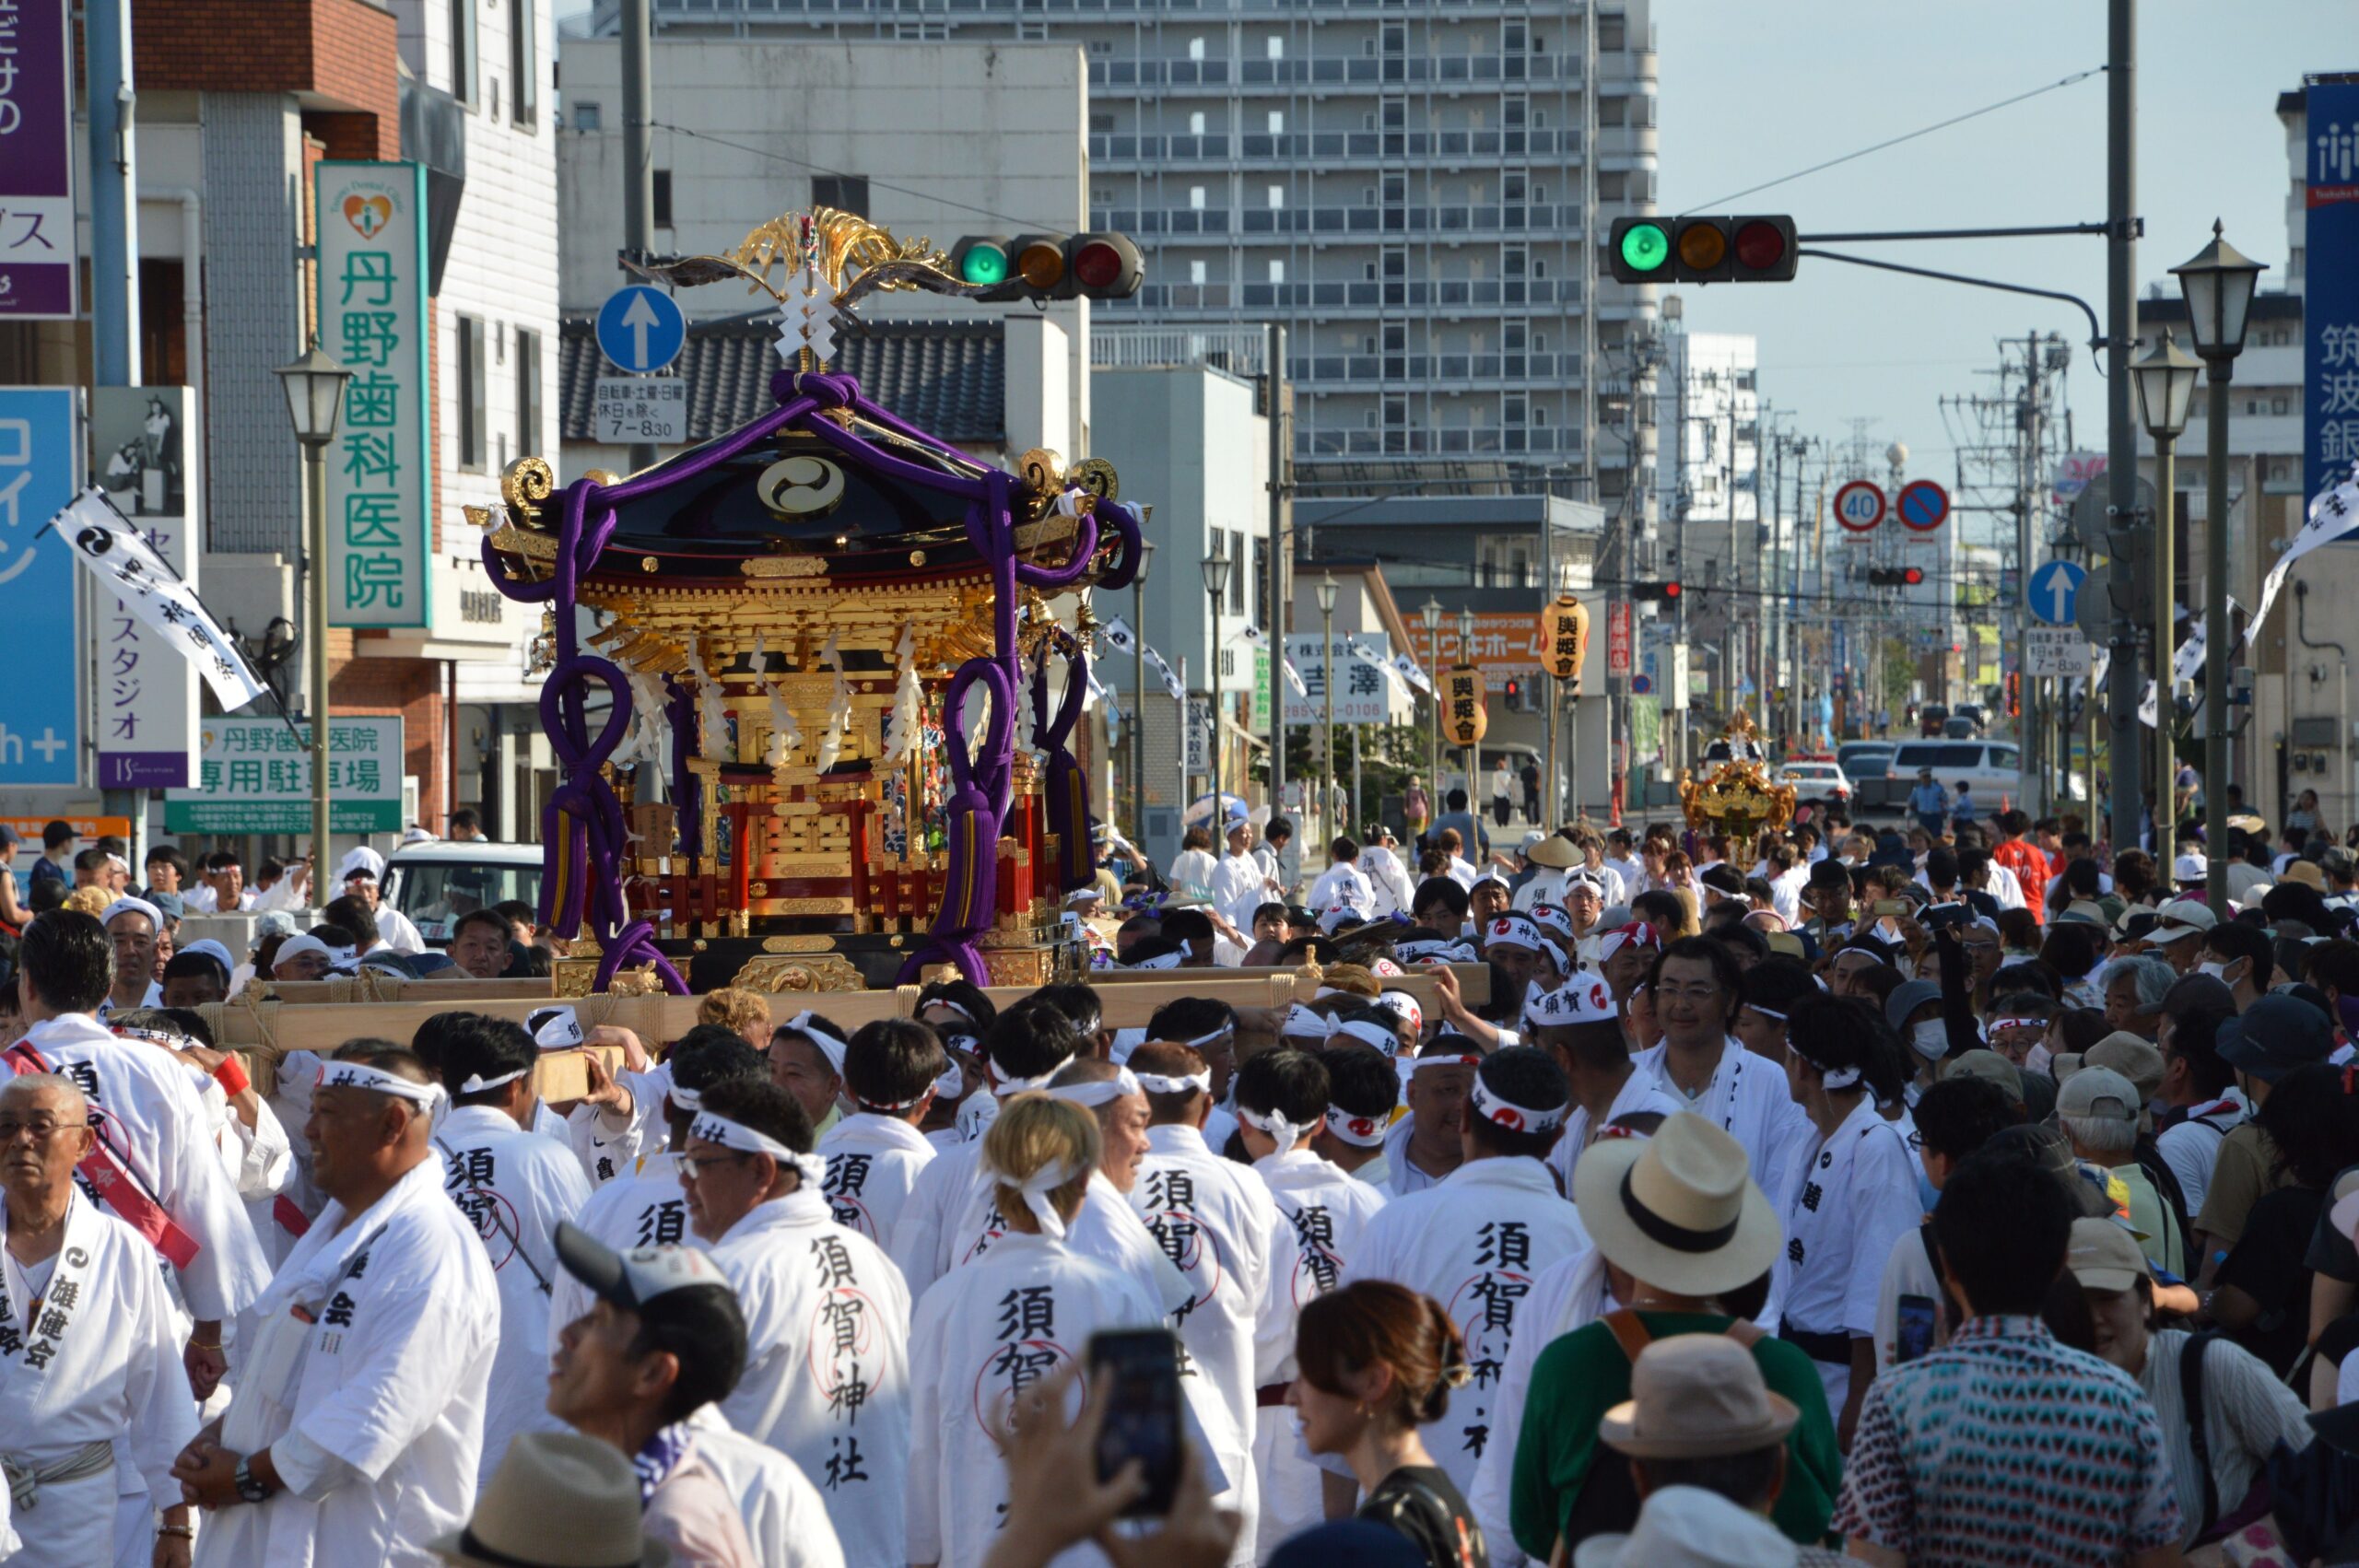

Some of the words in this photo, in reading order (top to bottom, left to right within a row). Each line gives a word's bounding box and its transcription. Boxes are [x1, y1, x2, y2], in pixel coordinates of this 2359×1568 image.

[600, 403, 659, 419] 休日を除く
[339, 251, 404, 610] 丹野歯科医院
[1845, 496, 1875, 519] 40
[1544, 989, 1581, 1014] 須賀
[810, 1235, 869, 1491] 須賀神社
